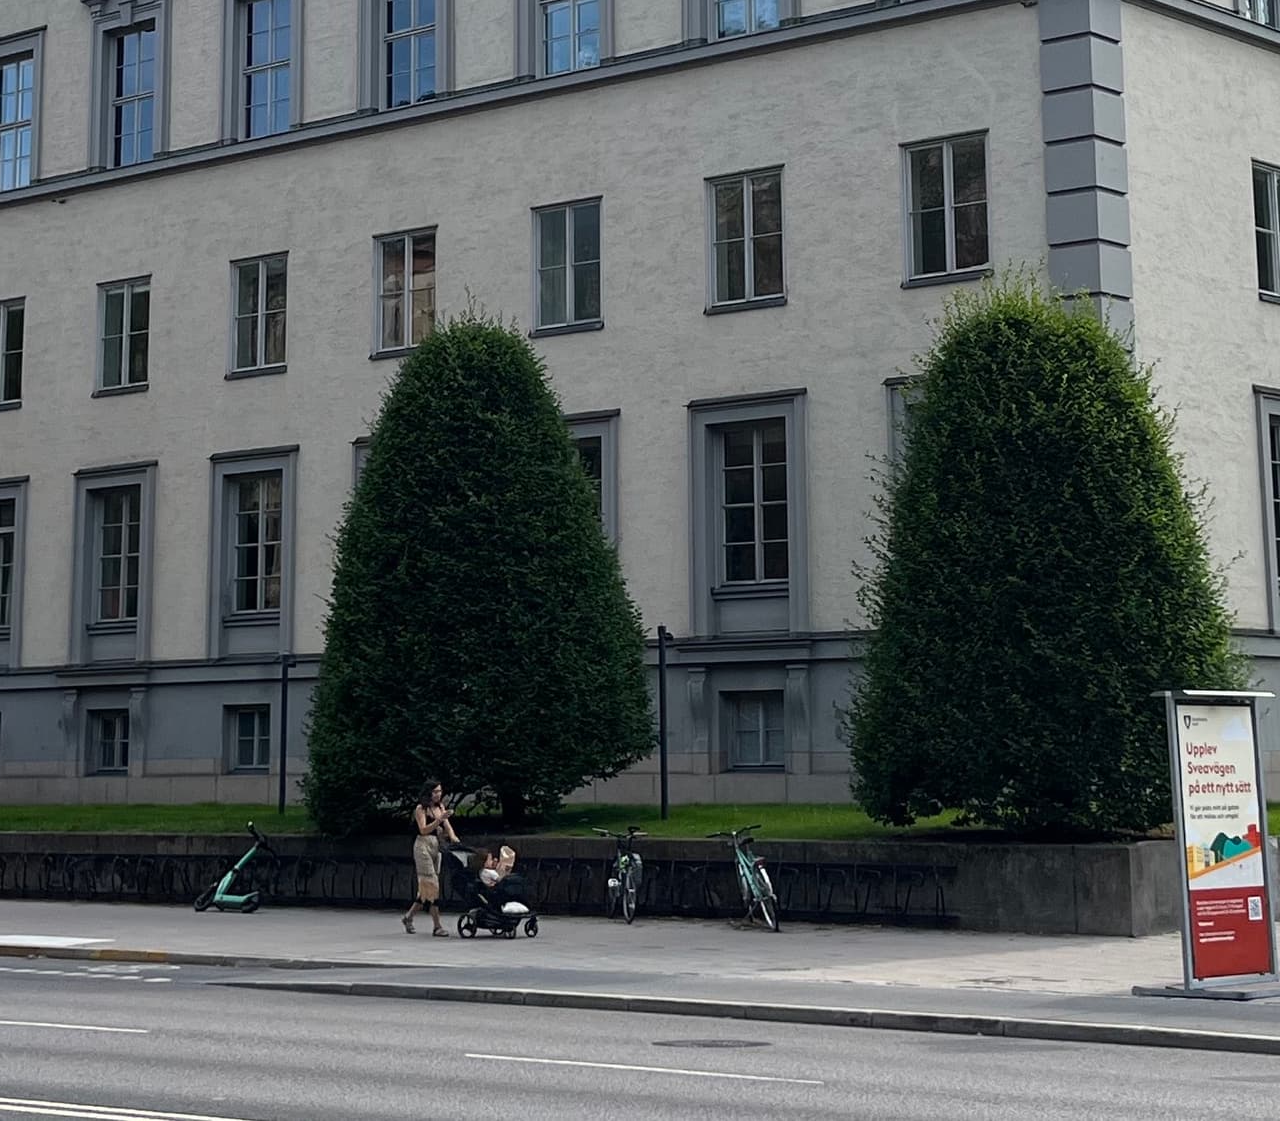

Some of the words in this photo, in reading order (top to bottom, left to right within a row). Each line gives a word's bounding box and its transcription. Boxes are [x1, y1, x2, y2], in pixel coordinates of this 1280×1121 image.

[1186, 741, 1217, 758] Upplev
[1187, 761, 1236, 777] Sveavägen
[1189, 779, 1200, 797] på
[1201, 782, 1215, 794] ett
[1216, 782, 1234, 796] nytt
[1235, 780, 1251, 793] sätt
